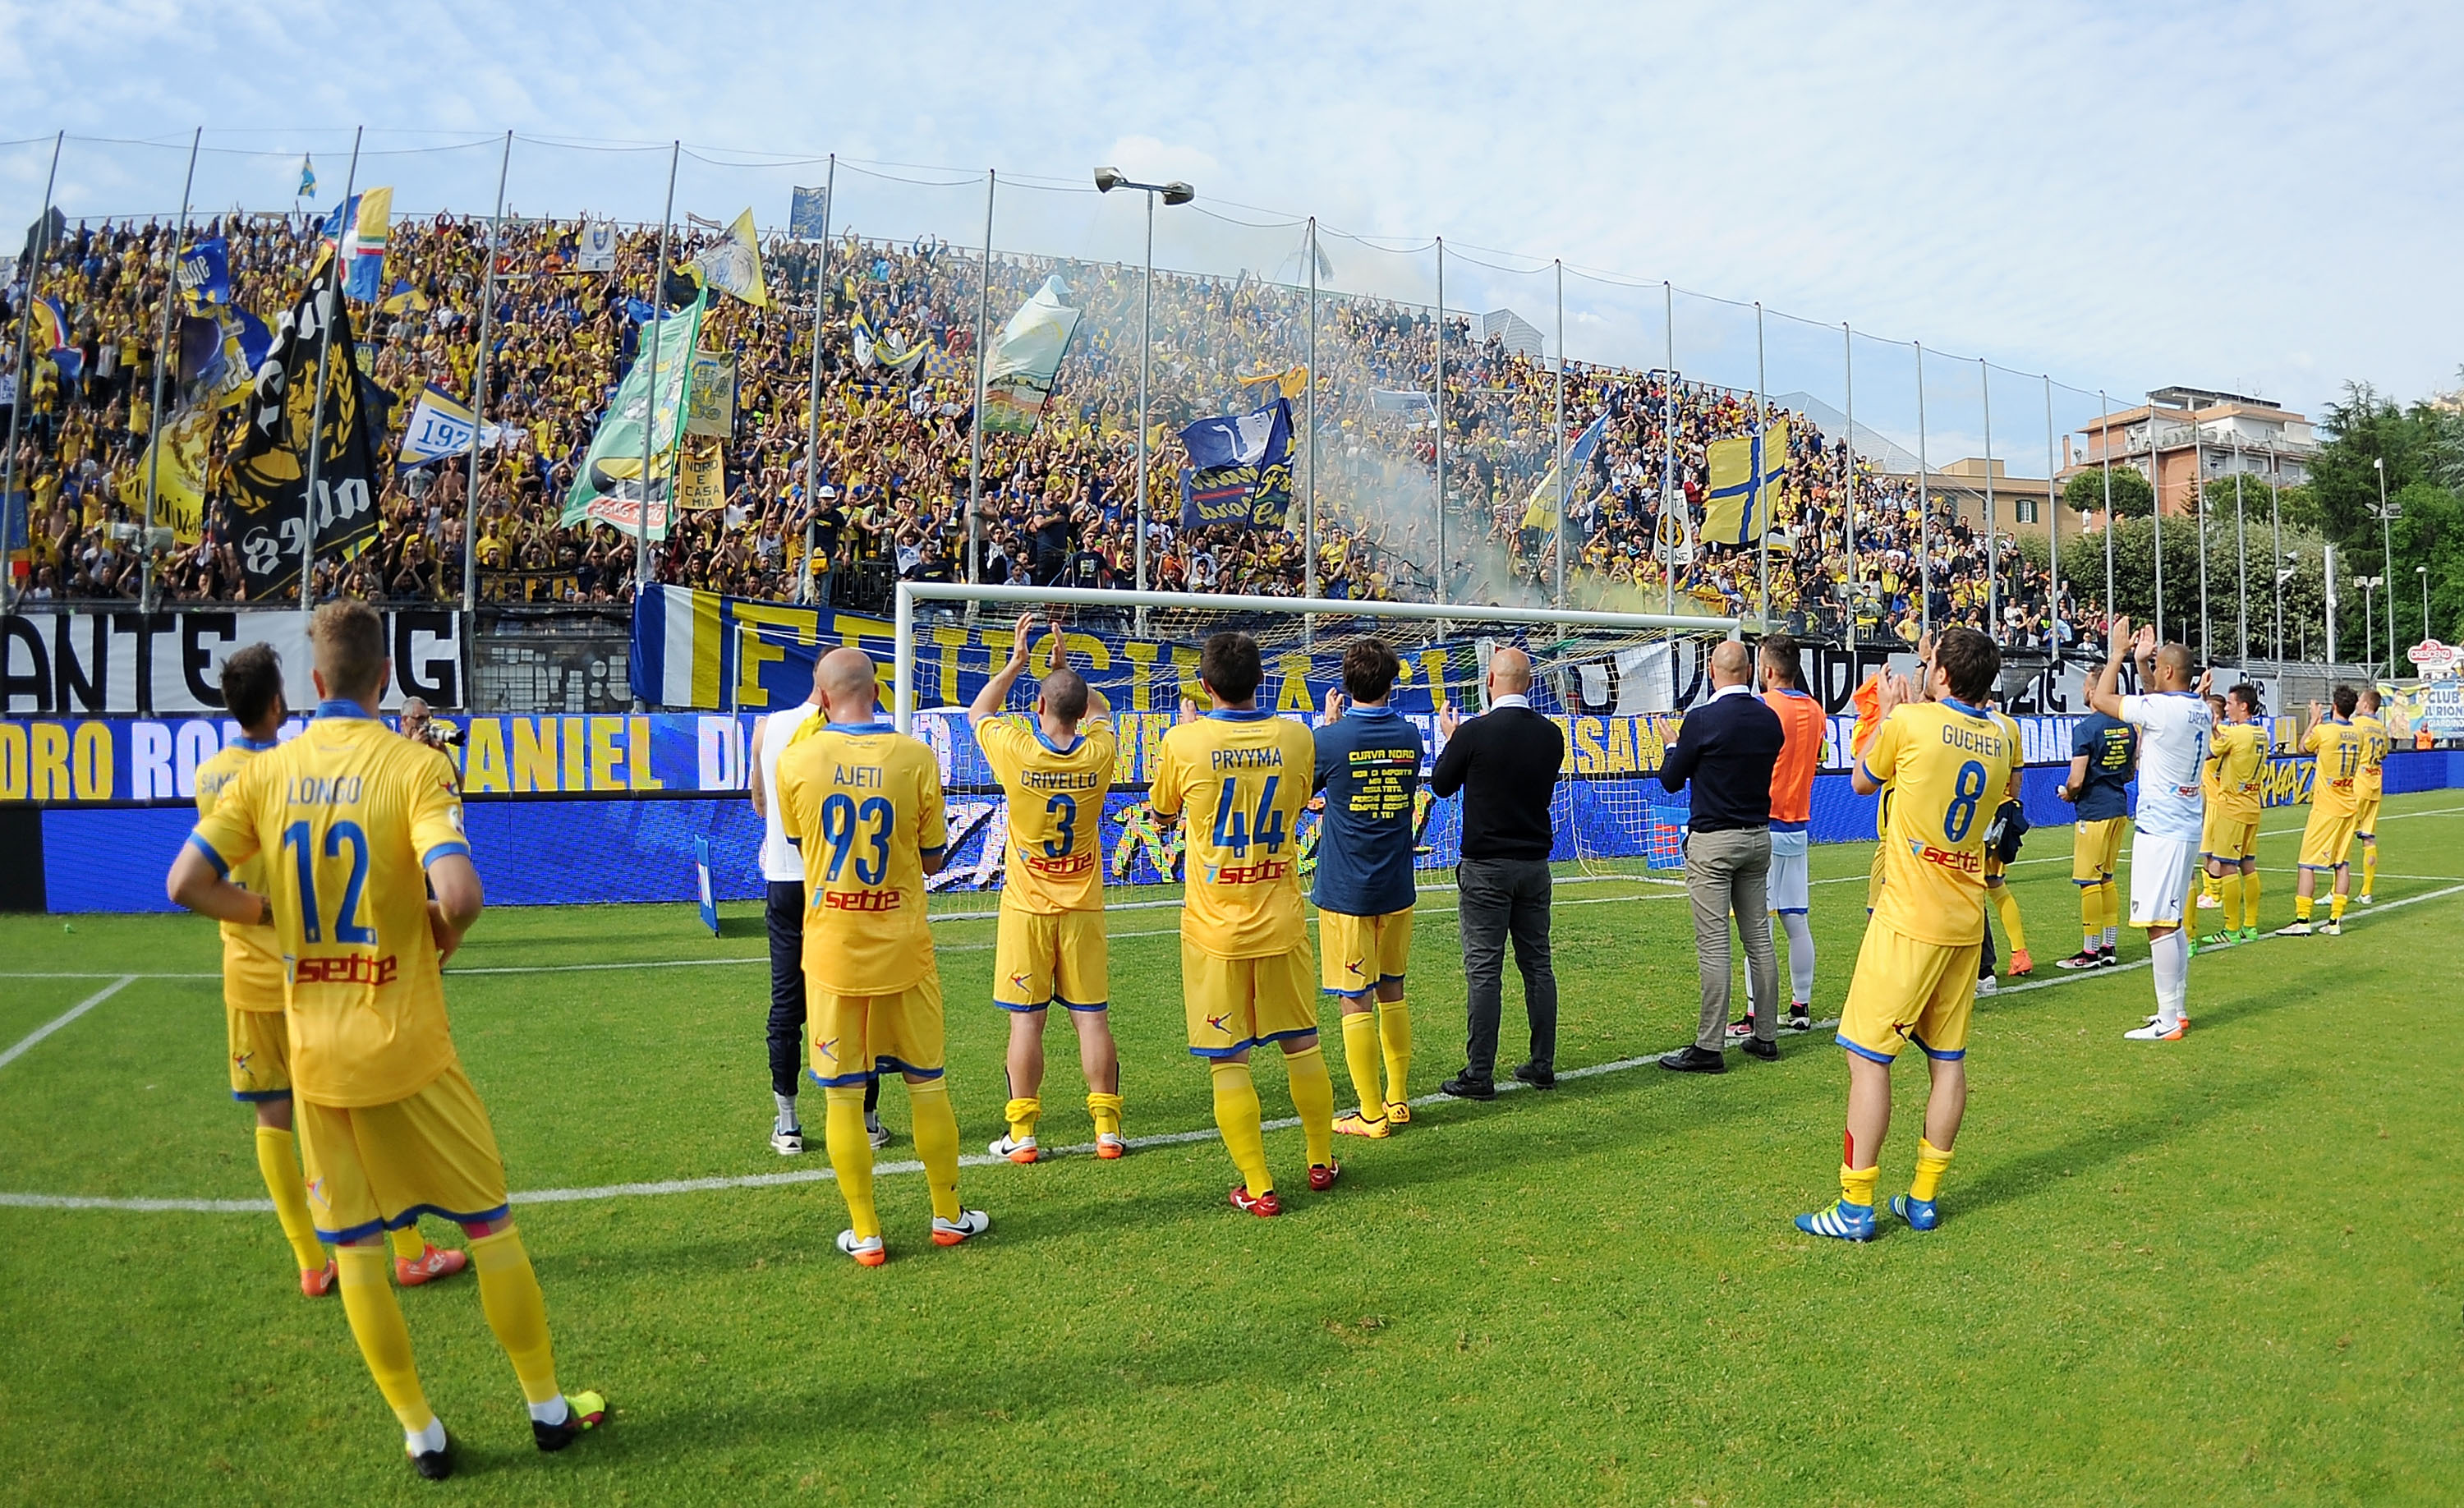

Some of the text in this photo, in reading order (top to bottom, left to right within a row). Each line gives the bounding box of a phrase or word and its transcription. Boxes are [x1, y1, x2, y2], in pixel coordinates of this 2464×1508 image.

[685, 460, 719, 473] NORD
[696, 475, 706, 485] E
[685, 485, 720, 497] CASA
[692, 498, 714, 507] MIA
[2428, 691, 2461, 704] CLUB
[438, 716, 664, 792] ANIEL
[1349, 749, 1414, 761] CURVA NORD
[1942, 724, 2002, 758] GUCHER
[2369, 737, 2387, 765] 13
[1211, 747, 1284, 770] PRYYMA
[2190, 730, 2204, 783] 1
[2253, 744, 2265, 780] 7
[2338, 743, 2358, 777] 11
[287, 775, 362, 805] LONGO
[833, 764, 883, 788] AJETI
[1021, 770, 1098, 790] CRIVELLO
[1943, 760, 1987, 843] 8
[1042, 793, 1078, 857] 3
[1212, 775, 1285, 859] 44
[821, 793, 894, 886] 93
[1923, 846, 1982, 873] sette
[283, 819, 378, 945] 12
[825, 890, 901, 912] sette
[297, 953, 398, 986] sette
